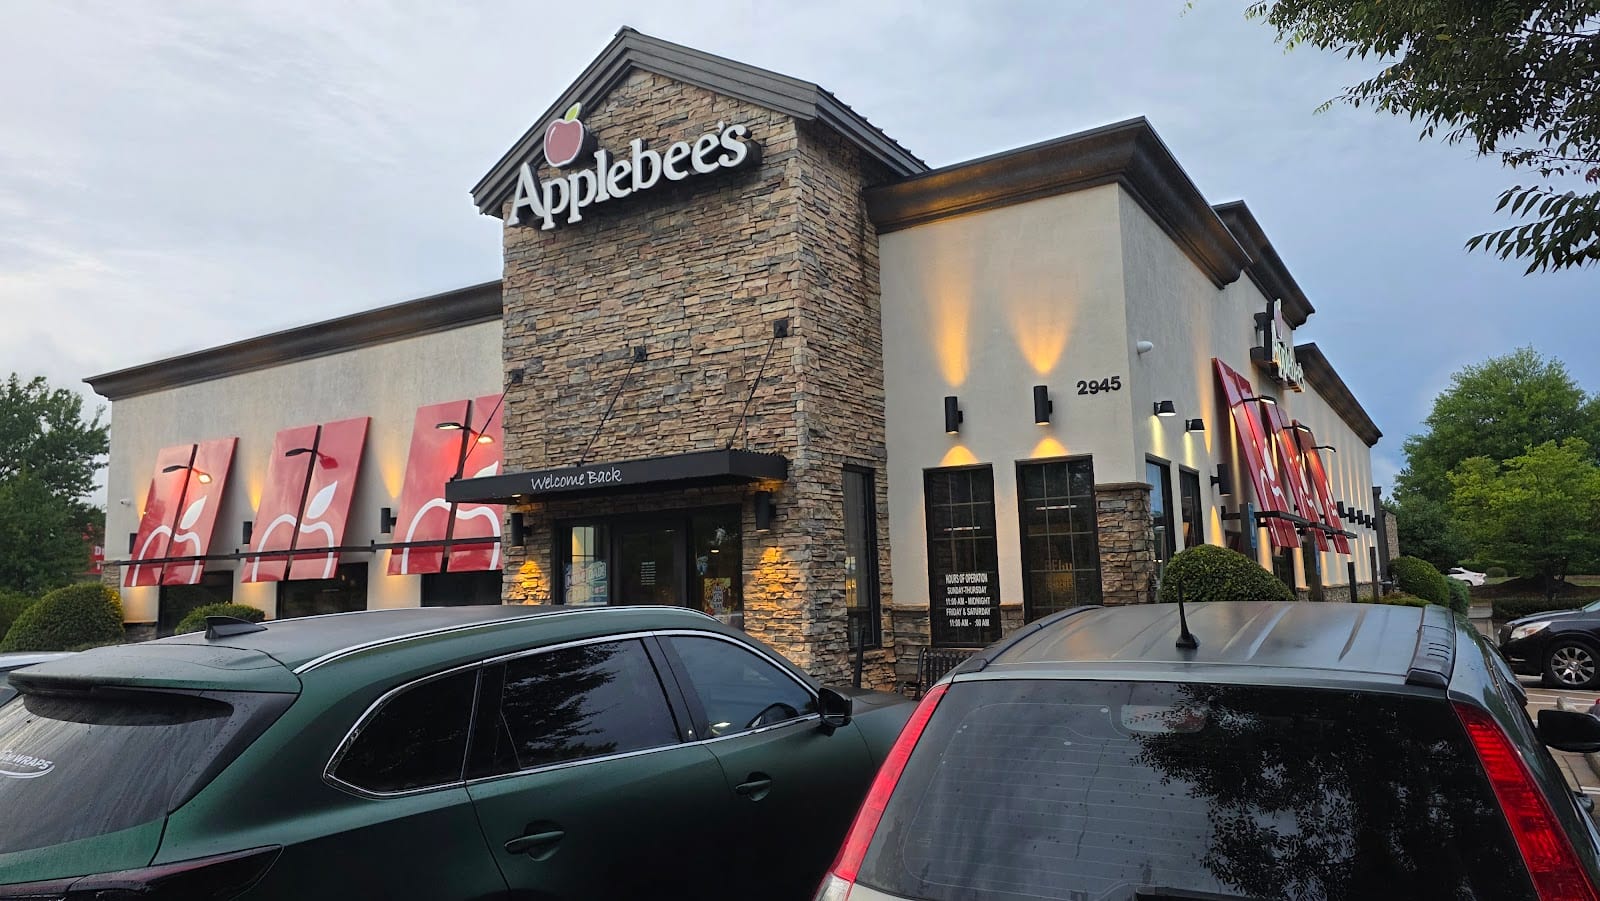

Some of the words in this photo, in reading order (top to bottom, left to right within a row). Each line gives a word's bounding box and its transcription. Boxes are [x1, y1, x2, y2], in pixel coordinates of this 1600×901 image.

[506, 121, 751, 231] Applebee's
[1076, 376, 1122, 395] 2945
[531, 472, 585, 491] Welcome
[587, 466, 623, 484] Back
[945, 574, 959, 584] HOURS
[960, 574, 965, 583] OF
[965, 573, 987, 583] OPERATION
[947, 586, 987, 595] SUNDAY-THURSDAY
[945, 597, 957, 605] 11:00
[957, 597, 965, 605] AM
[967, 597, 990, 605] MIDNIGHT
[946, 608, 963, 616] FRIDAY
[967, 607, 991, 616] SATURDAY
[949, 619, 961, 627] 11:00
[961, 619, 969, 627] AM
